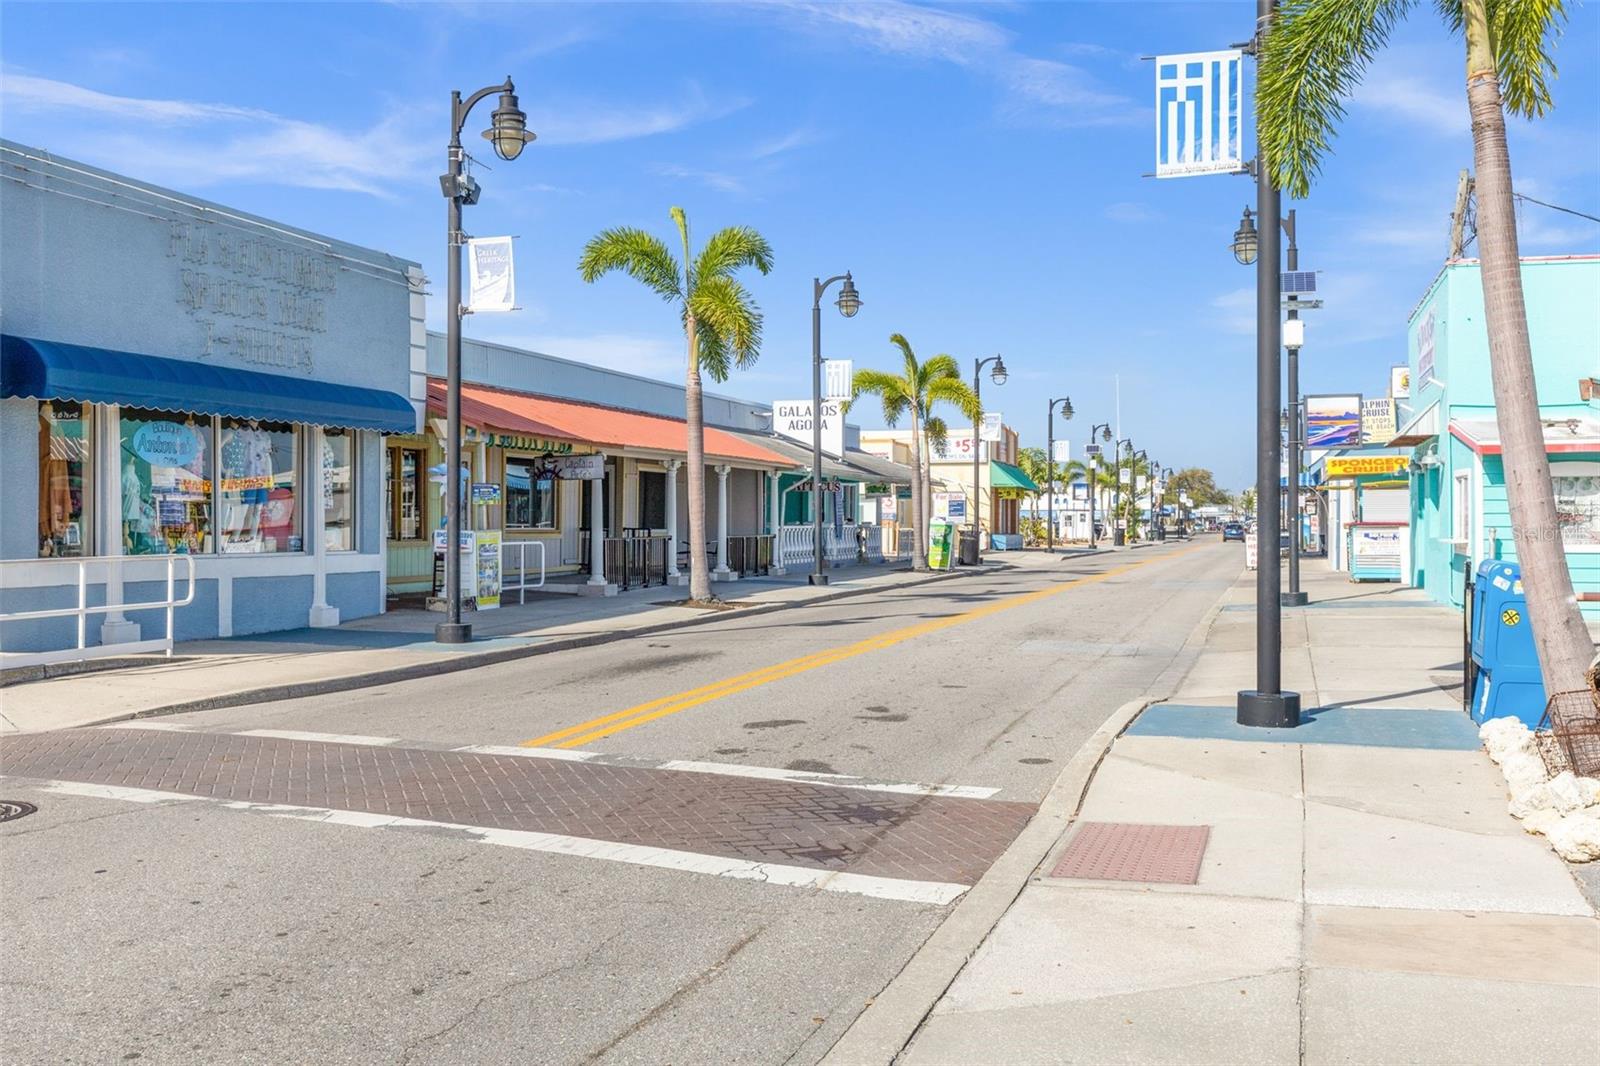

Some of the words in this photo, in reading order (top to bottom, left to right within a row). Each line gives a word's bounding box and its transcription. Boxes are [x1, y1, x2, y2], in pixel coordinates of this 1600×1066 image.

[779, 405, 838, 417] GALAOS
[788, 419, 828, 431] AGOA
[1331, 457, 1409, 467] SPONGEO
[793, 482, 841, 492] ATTCUS
